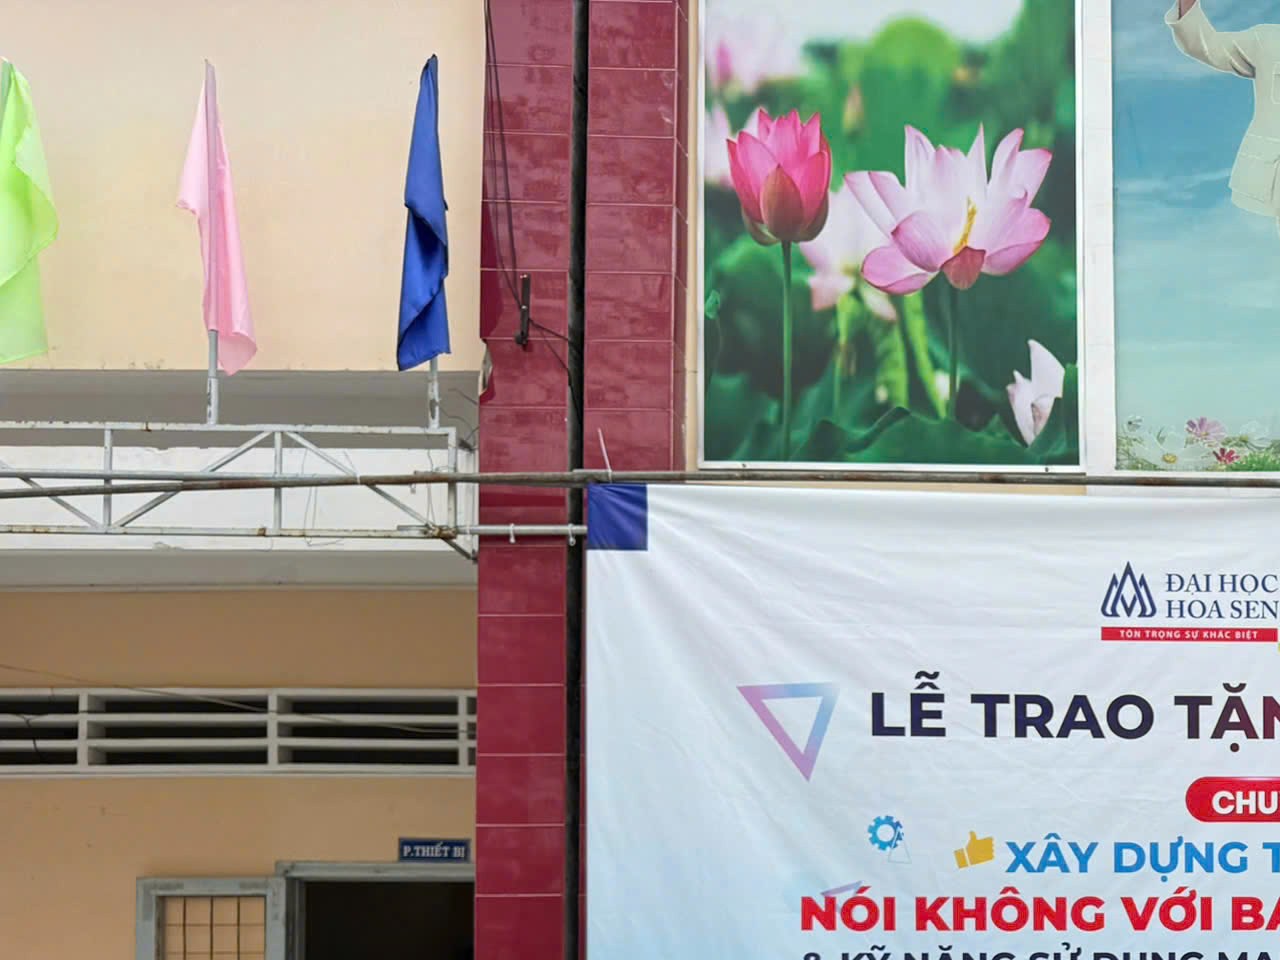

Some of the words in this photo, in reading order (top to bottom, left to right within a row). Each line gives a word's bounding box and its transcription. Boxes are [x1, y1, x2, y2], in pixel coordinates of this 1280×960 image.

[1165, 573, 1212, 595] ĐẠI
[1218, 573, 1279, 596] HỌC
[1165, 599, 1228, 619] HOA
[1229, 599, 1279, 619] SEN
[1119, 628, 1141, 639] TÔN
[1145, 629, 1182, 641] TRỌNG
[1185, 629, 1199, 641] SỰ
[1203, 628, 1231, 639] KHÁC
[1235, 629, 1258, 641] BIỆT
[871, 671, 946, 738] LỄ
[970, 693, 1155, 740] TRAO
[1005, 832, 1099, 873] XÂY
[1113, 836, 1248, 883] DỰNG
[800, 885, 896, 932] NÓI
[914, 886, 1106, 932] KHÔNG
[1119, 886, 1212, 931] VỚI
